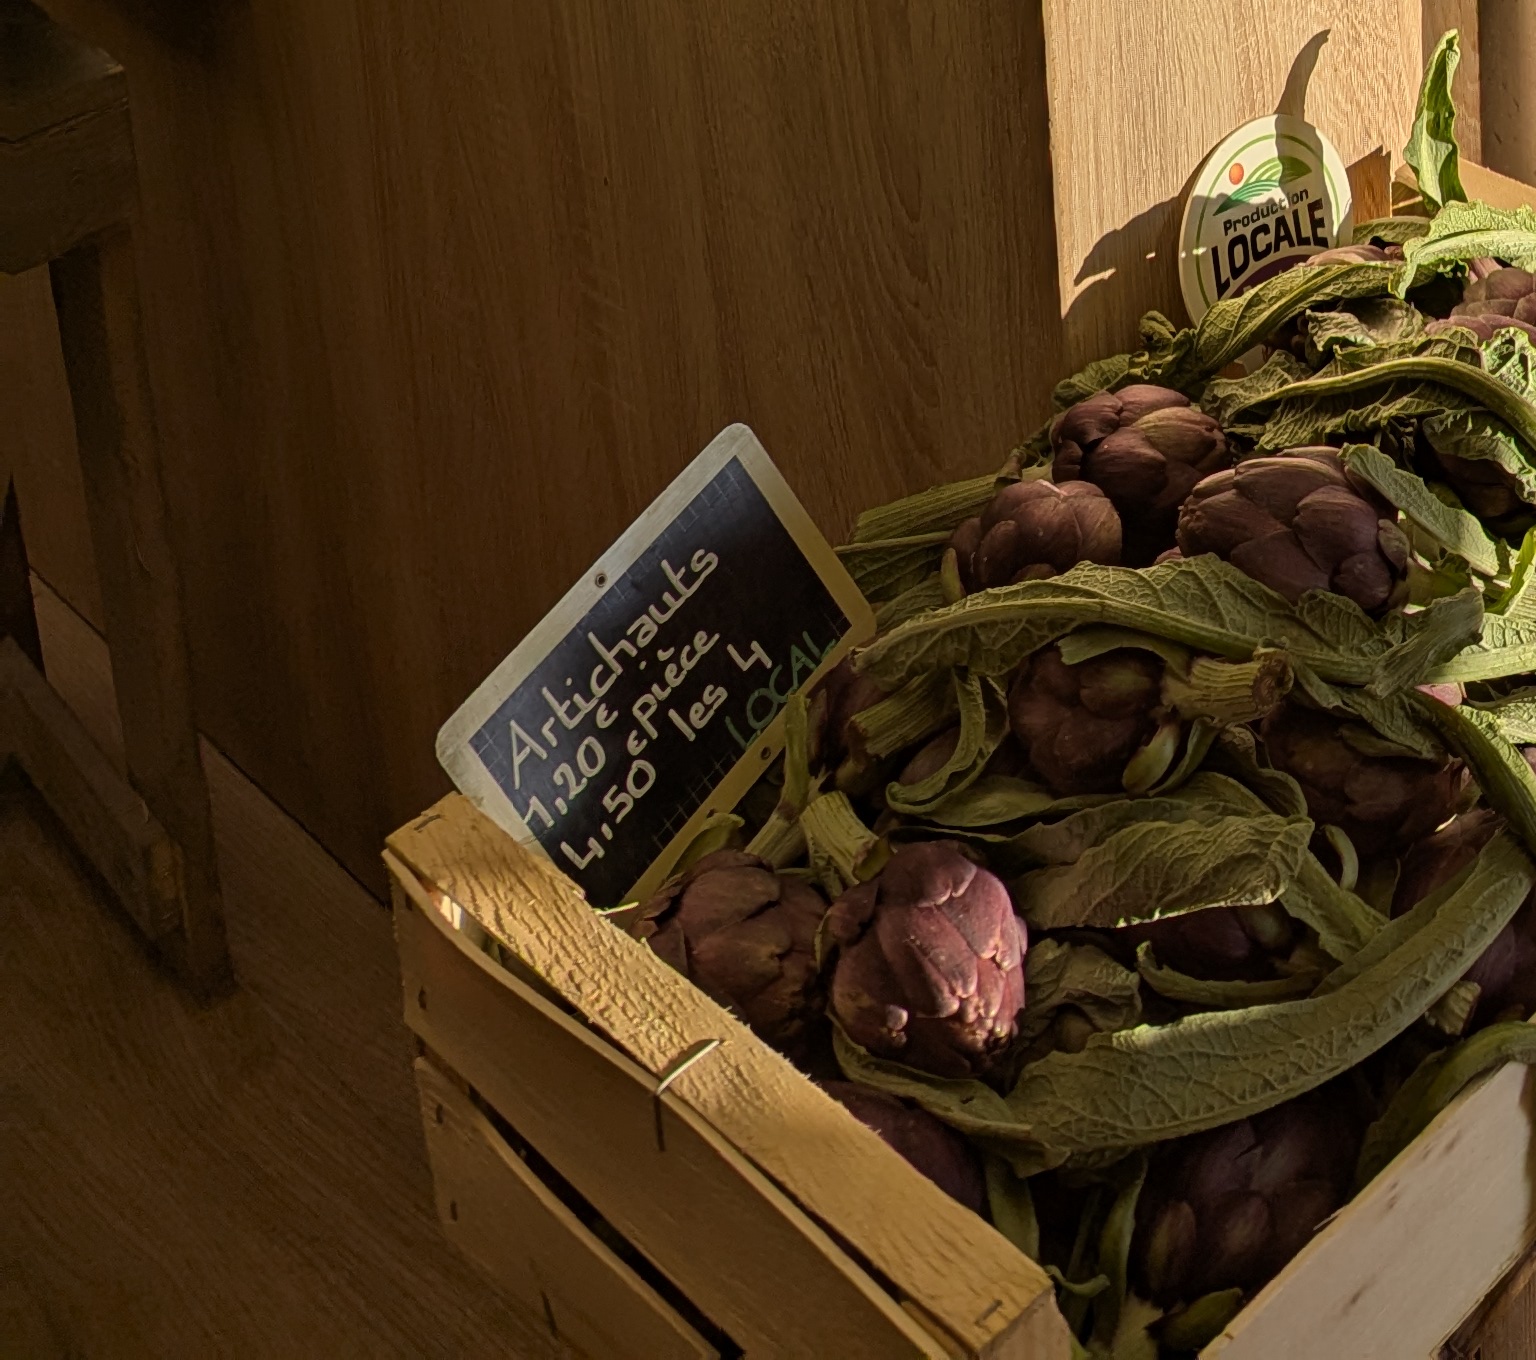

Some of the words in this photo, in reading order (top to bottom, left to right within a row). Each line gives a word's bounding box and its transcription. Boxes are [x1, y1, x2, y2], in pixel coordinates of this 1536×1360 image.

[1211, 198, 1329, 300] LOCALE
[1223, 188, 1309, 237] Production
[511, 548, 719, 789] Artichauts
[668, 684, 728, 741] les
[727, 640, 772, 672] 4
